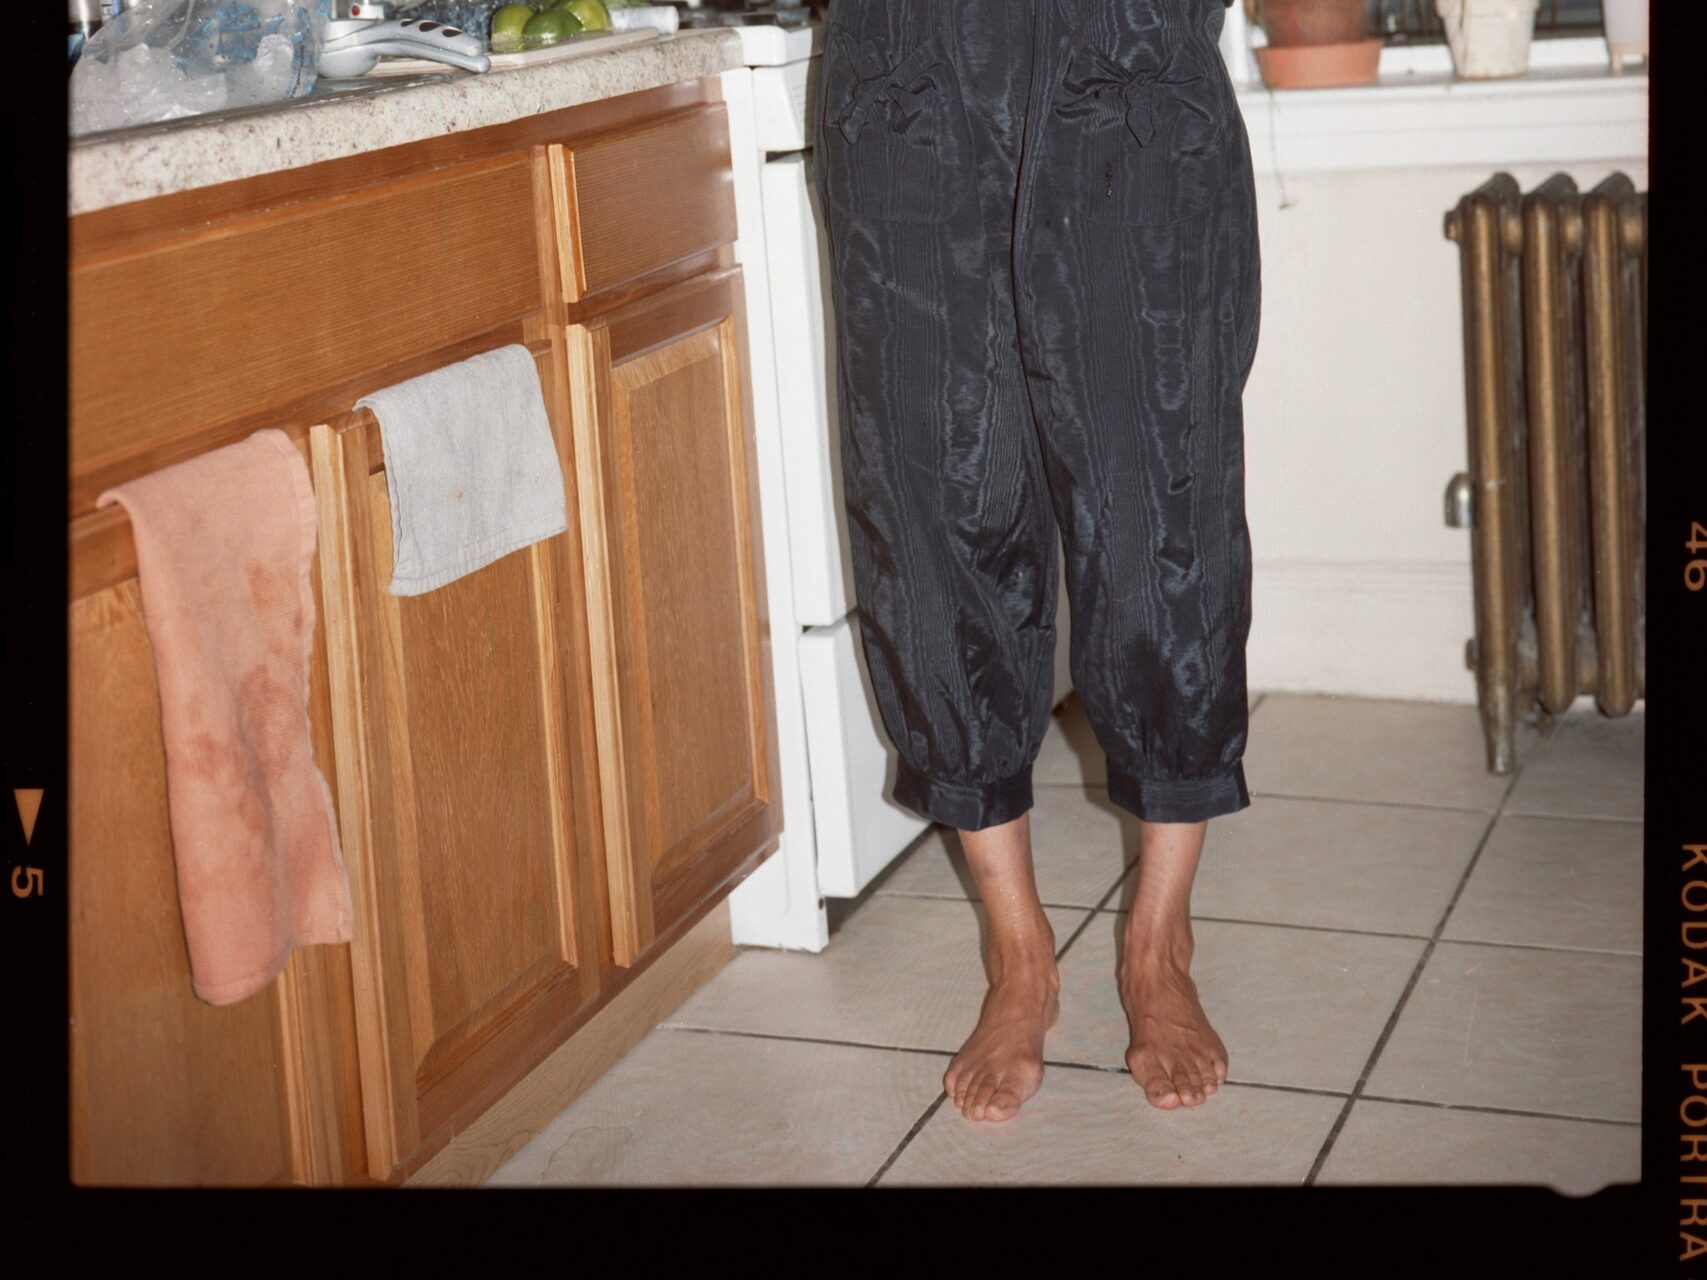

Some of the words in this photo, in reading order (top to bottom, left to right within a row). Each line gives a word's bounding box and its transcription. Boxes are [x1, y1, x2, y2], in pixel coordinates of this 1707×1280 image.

[1685, 522, 1707, 591] 46
[11, 867, 42, 898] 5
[1682, 844, 1707, 1023] KODAK
[1680, 1064, 1707, 1260] PORTRA
